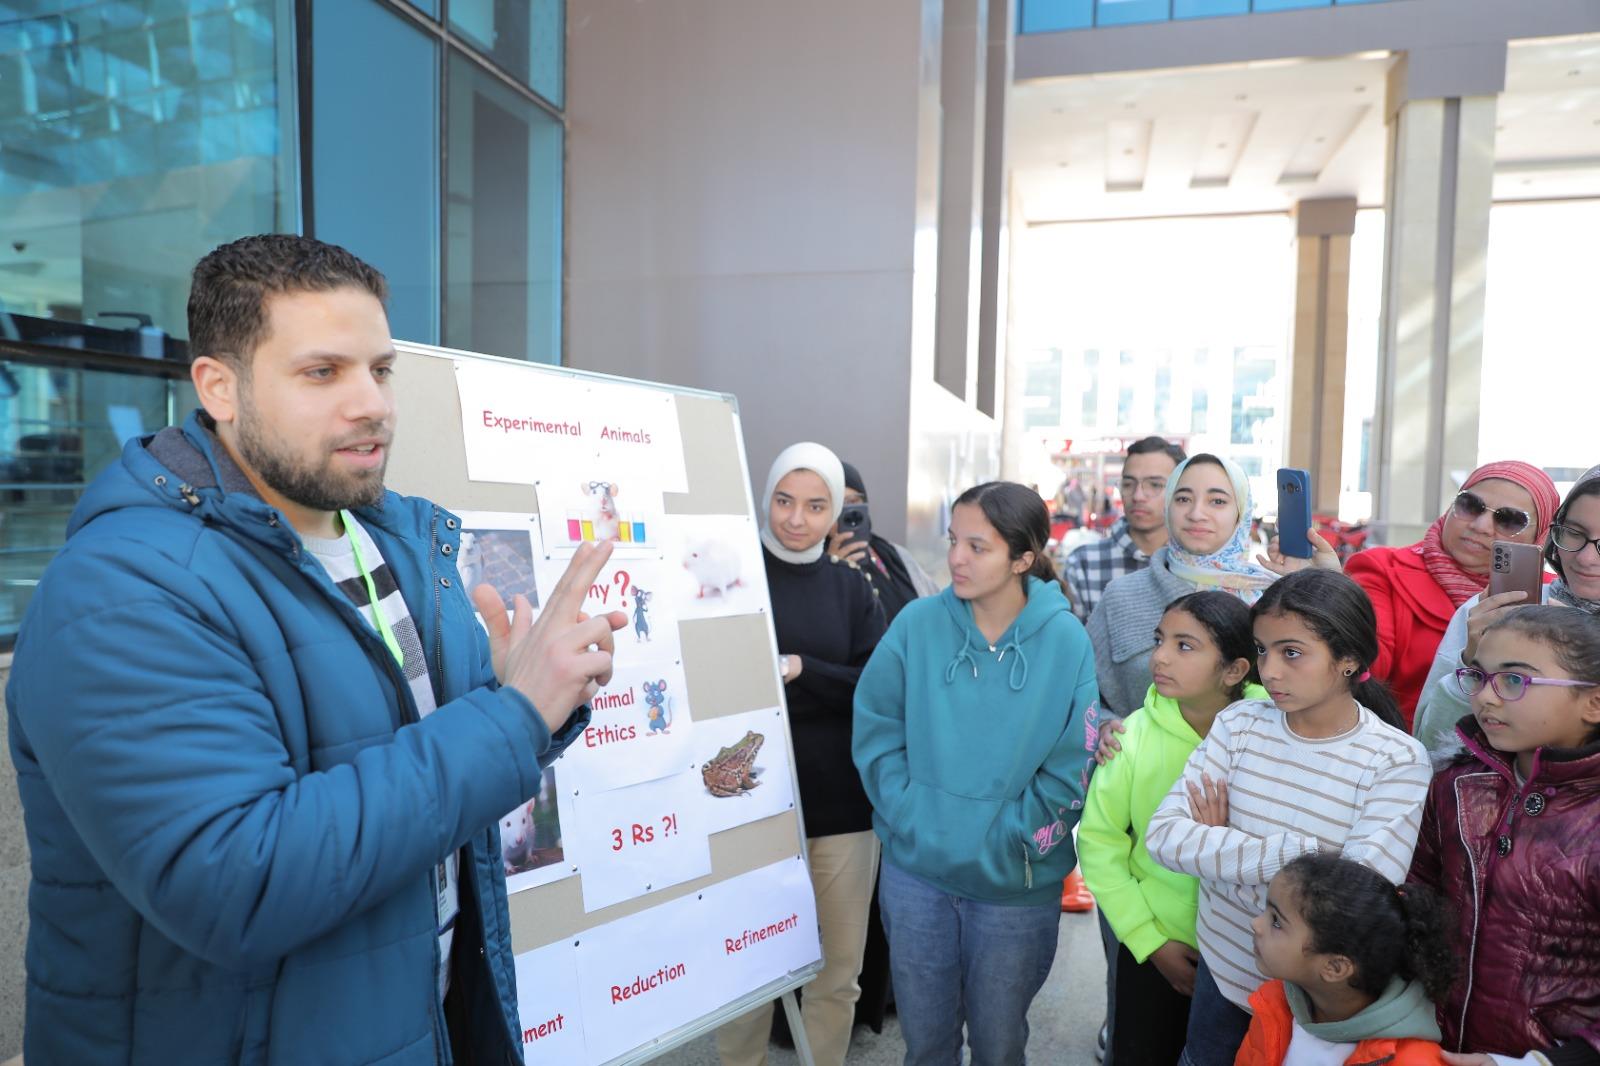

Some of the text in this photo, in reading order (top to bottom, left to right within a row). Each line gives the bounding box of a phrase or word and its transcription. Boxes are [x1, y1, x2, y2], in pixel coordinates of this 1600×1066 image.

[483, 410, 652, 445] Experimental Animals
[585, 723, 636, 748] Ethics
[611, 812, 678, 851] 3 Rs ?!
[724, 912, 800, 955] Refinement
[610, 962, 687, 1005] Reduction
[521, 1013, 564, 1044] ment
